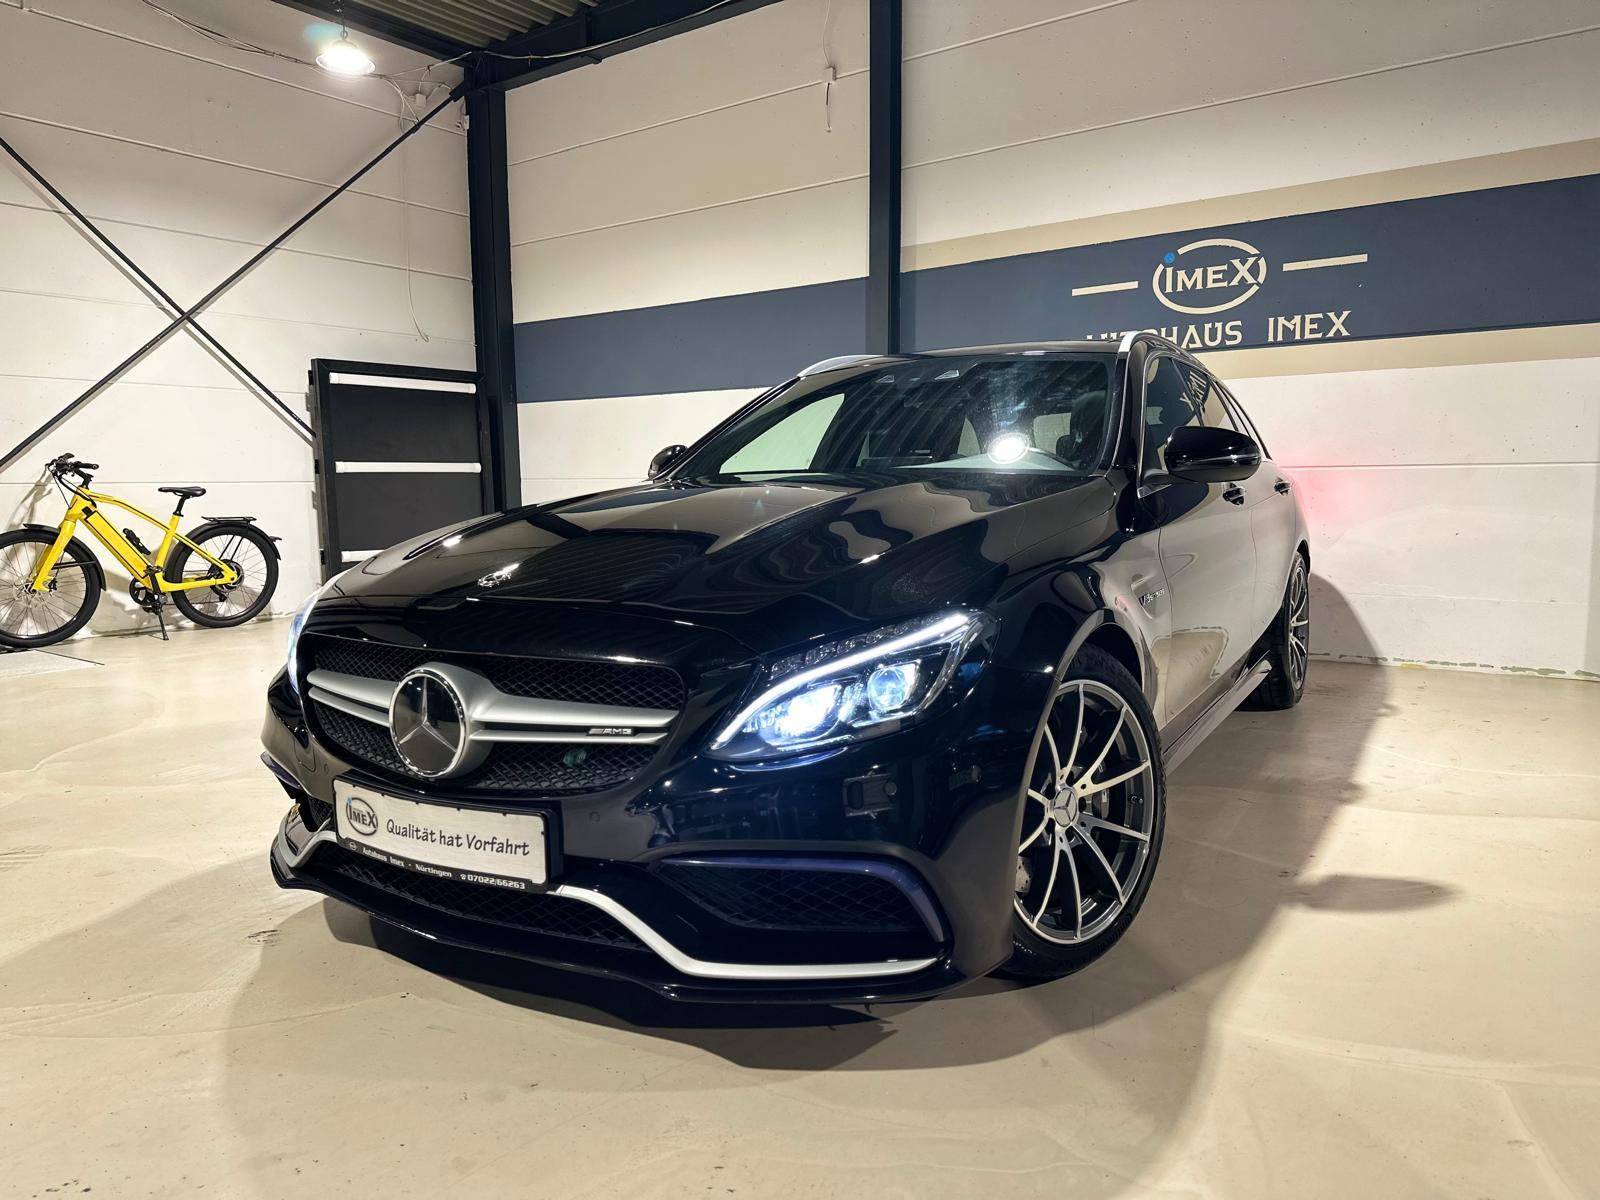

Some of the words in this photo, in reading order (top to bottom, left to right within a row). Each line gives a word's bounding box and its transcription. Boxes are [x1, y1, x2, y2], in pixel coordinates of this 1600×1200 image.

[1163, 255, 1258, 293] IMEX
[1267, 310, 1351, 342] IMEX
[386, 818, 437, 843] Qualität
[439, 829, 463, 848] hat
[466, 833, 530, 856] Vorfahrt
[415, 863, 453, 878] Nürtingen
